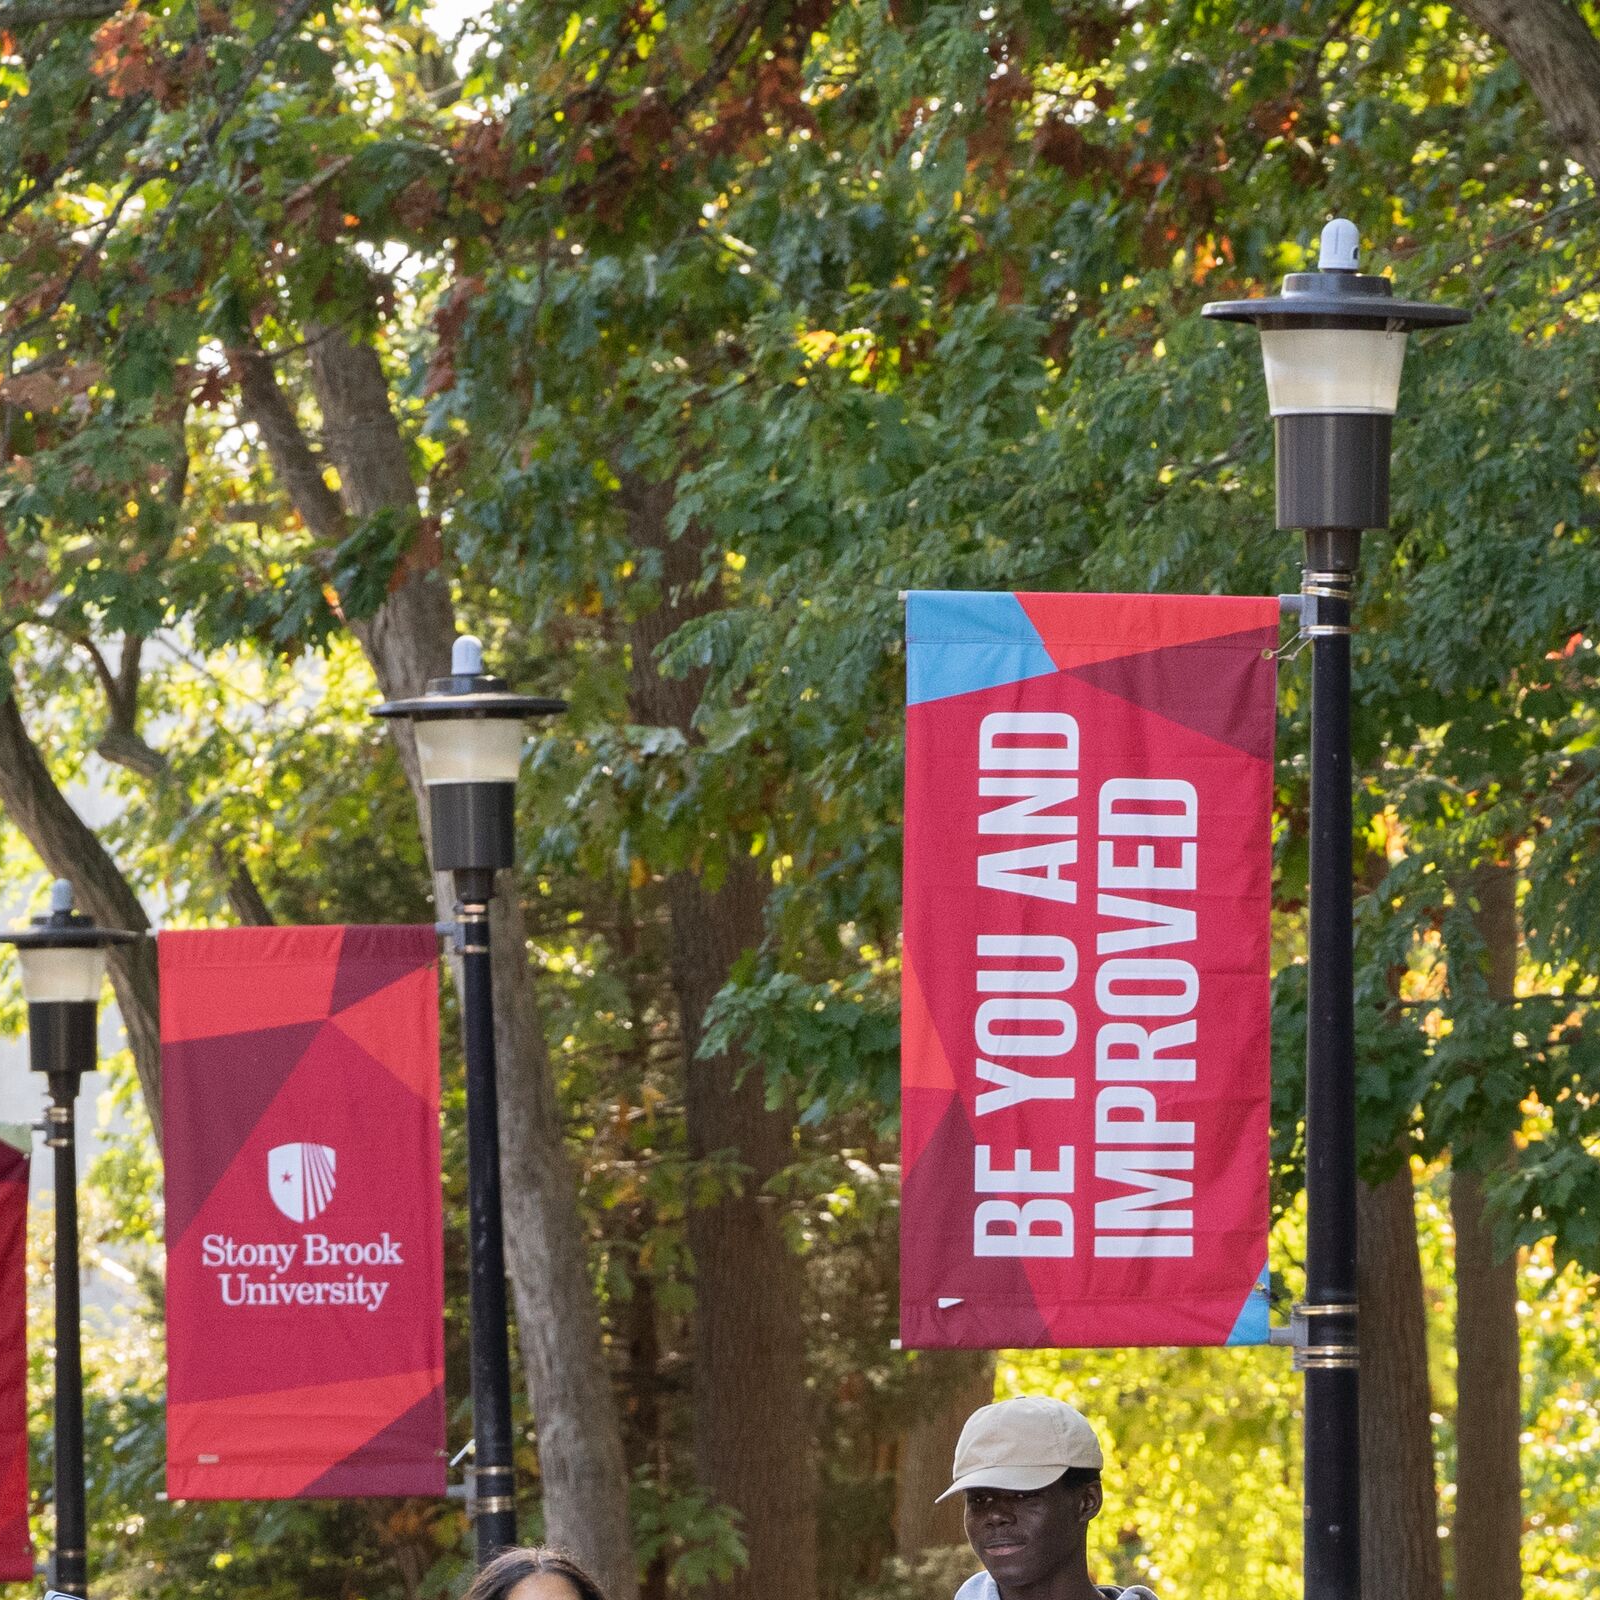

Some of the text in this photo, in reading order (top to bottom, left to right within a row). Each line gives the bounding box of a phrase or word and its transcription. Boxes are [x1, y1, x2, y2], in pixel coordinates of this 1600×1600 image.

[973, 711, 1080, 1258] BE YOU AND
[1093, 777, 1200, 1258] IMPROVED
[202, 1232, 404, 1273] Stony Brook
[217, 1272, 390, 1312] University
